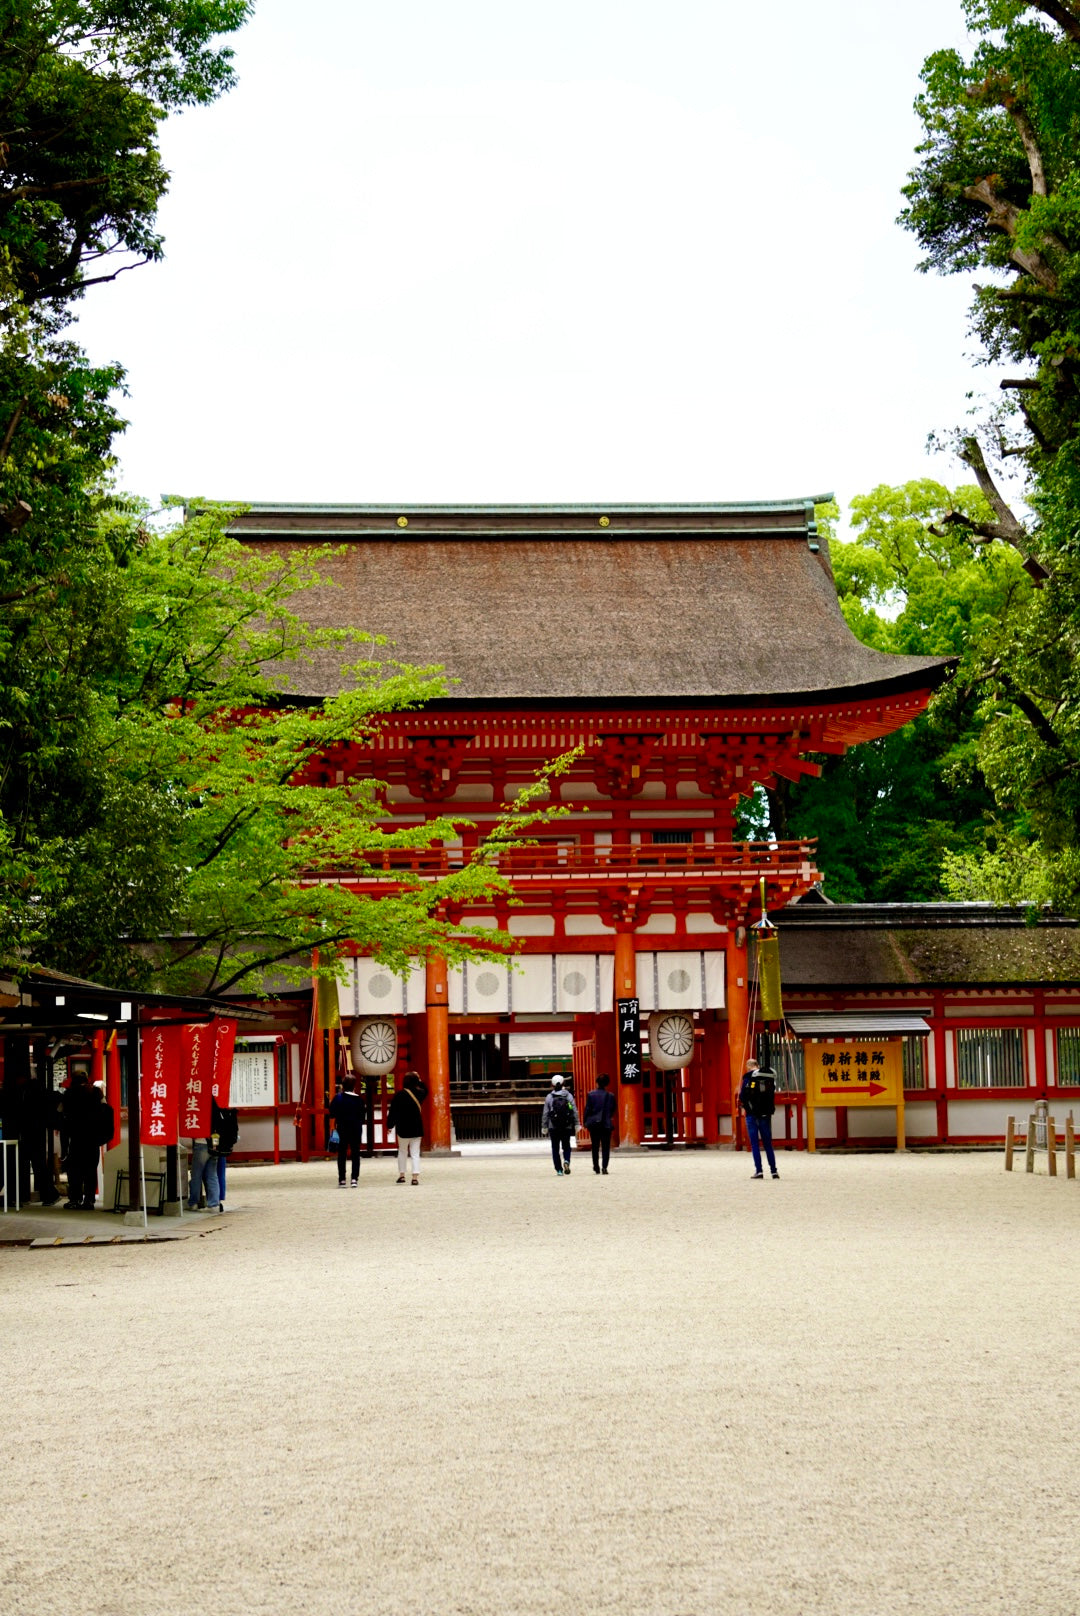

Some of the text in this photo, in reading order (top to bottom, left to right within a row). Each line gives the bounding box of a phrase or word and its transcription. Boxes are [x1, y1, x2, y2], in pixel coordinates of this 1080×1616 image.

[623, 1019, 640, 1079] 月次祭
[149, 1033, 167, 1136] えんむすび 相生社
[185, 1078, 202, 1130] 相生社
